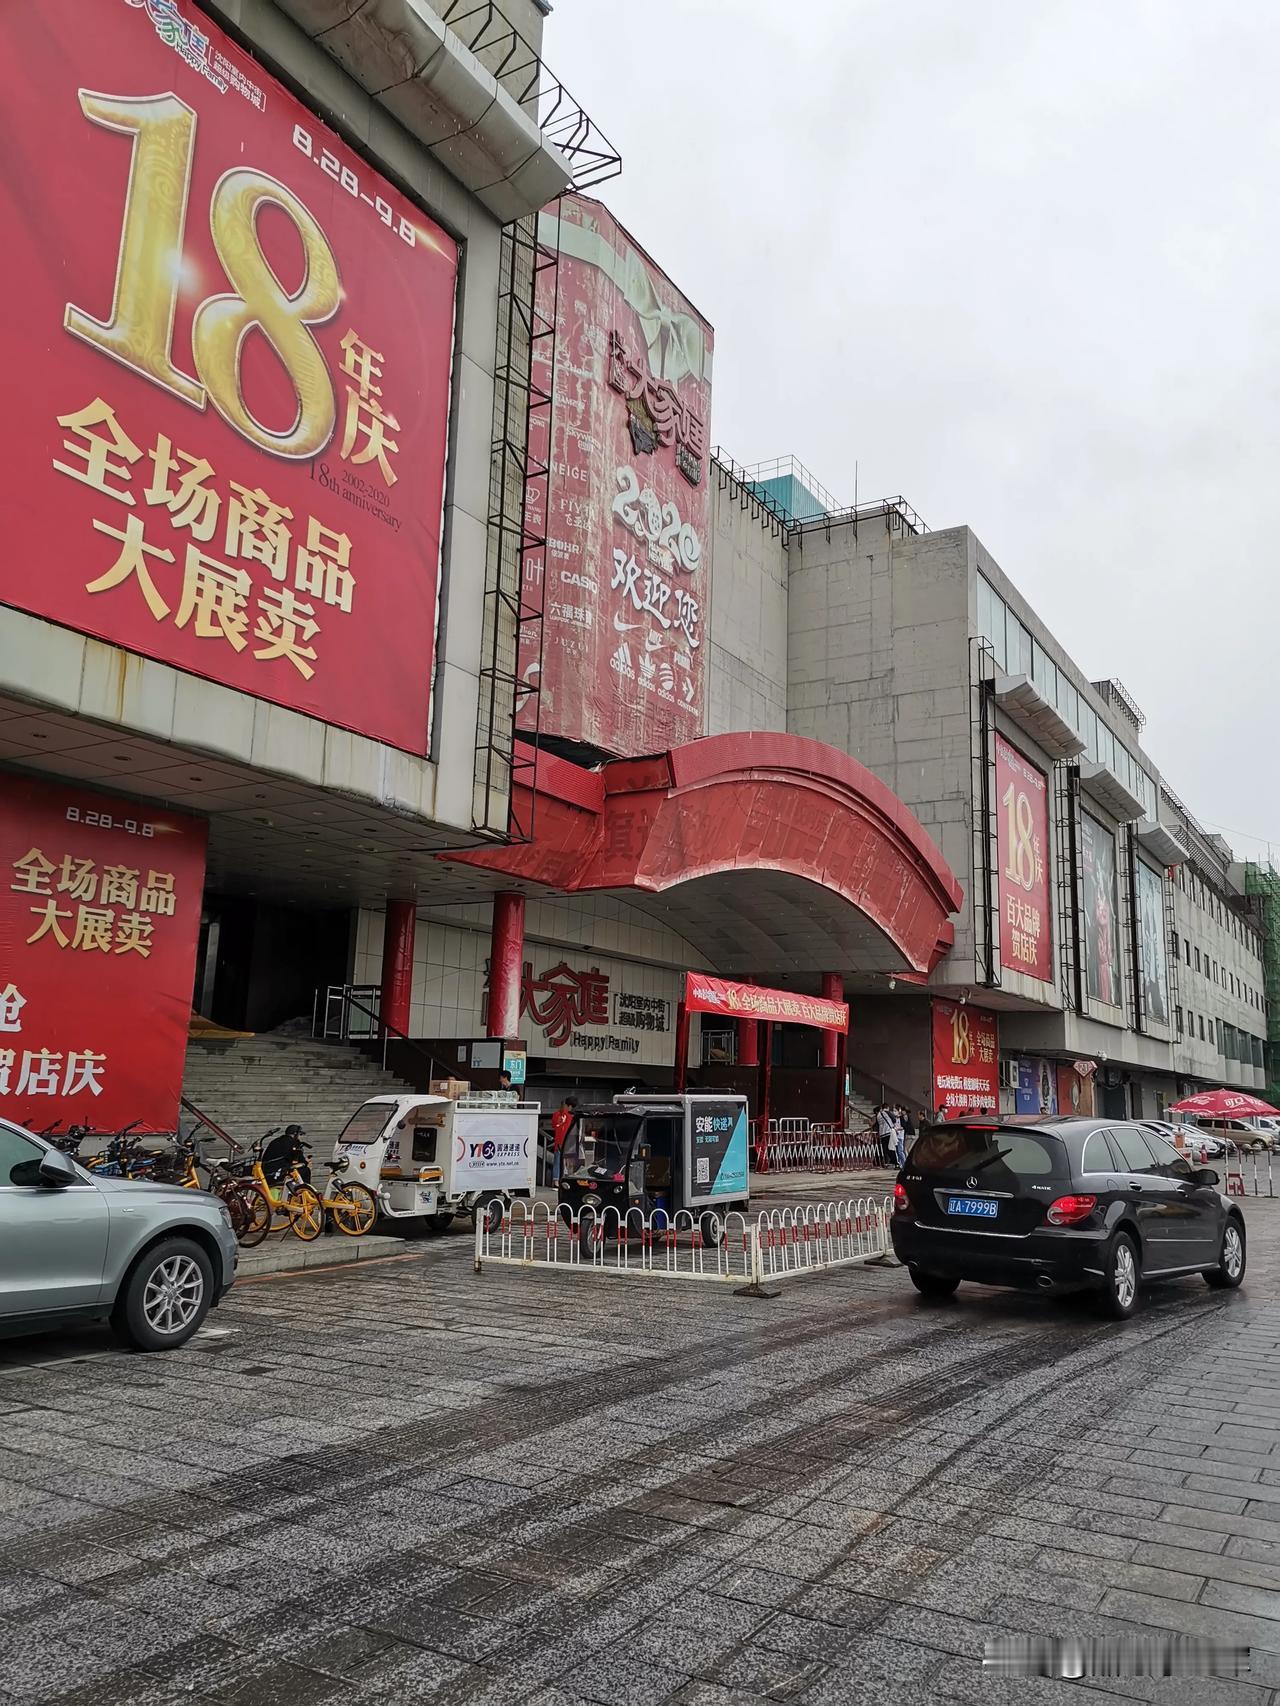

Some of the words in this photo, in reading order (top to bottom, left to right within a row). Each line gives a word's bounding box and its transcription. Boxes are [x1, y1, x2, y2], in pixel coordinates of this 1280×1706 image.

[201, 63, 228, 94] Family
[292, 125, 417, 247] 8.28-9.8
[65, 88, 346, 460] 18
[339, 329, 401, 487] 年庆
[53, 397, 356, 613] 全场商品
[310, 459, 341, 495] 18th
[342, 487, 401, 533] anniversary
[341, 469, 390, 508] 2002-2020
[86, 514, 321, 681] 大展卖
[611, 547, 700, 648] 欢迎您
[66, 806, 155, 838] 8.28-9.8
[1003, 781, 1035, 892] 18
[10, 847, 176, 917] 全场商品
[1007, 893, 1041, 939] 百大品牌
[26, 899, 156, 958] 大展卖
[571, 1031, 606, 1050] Happy
[950, 1008, 970, 1065] 18
